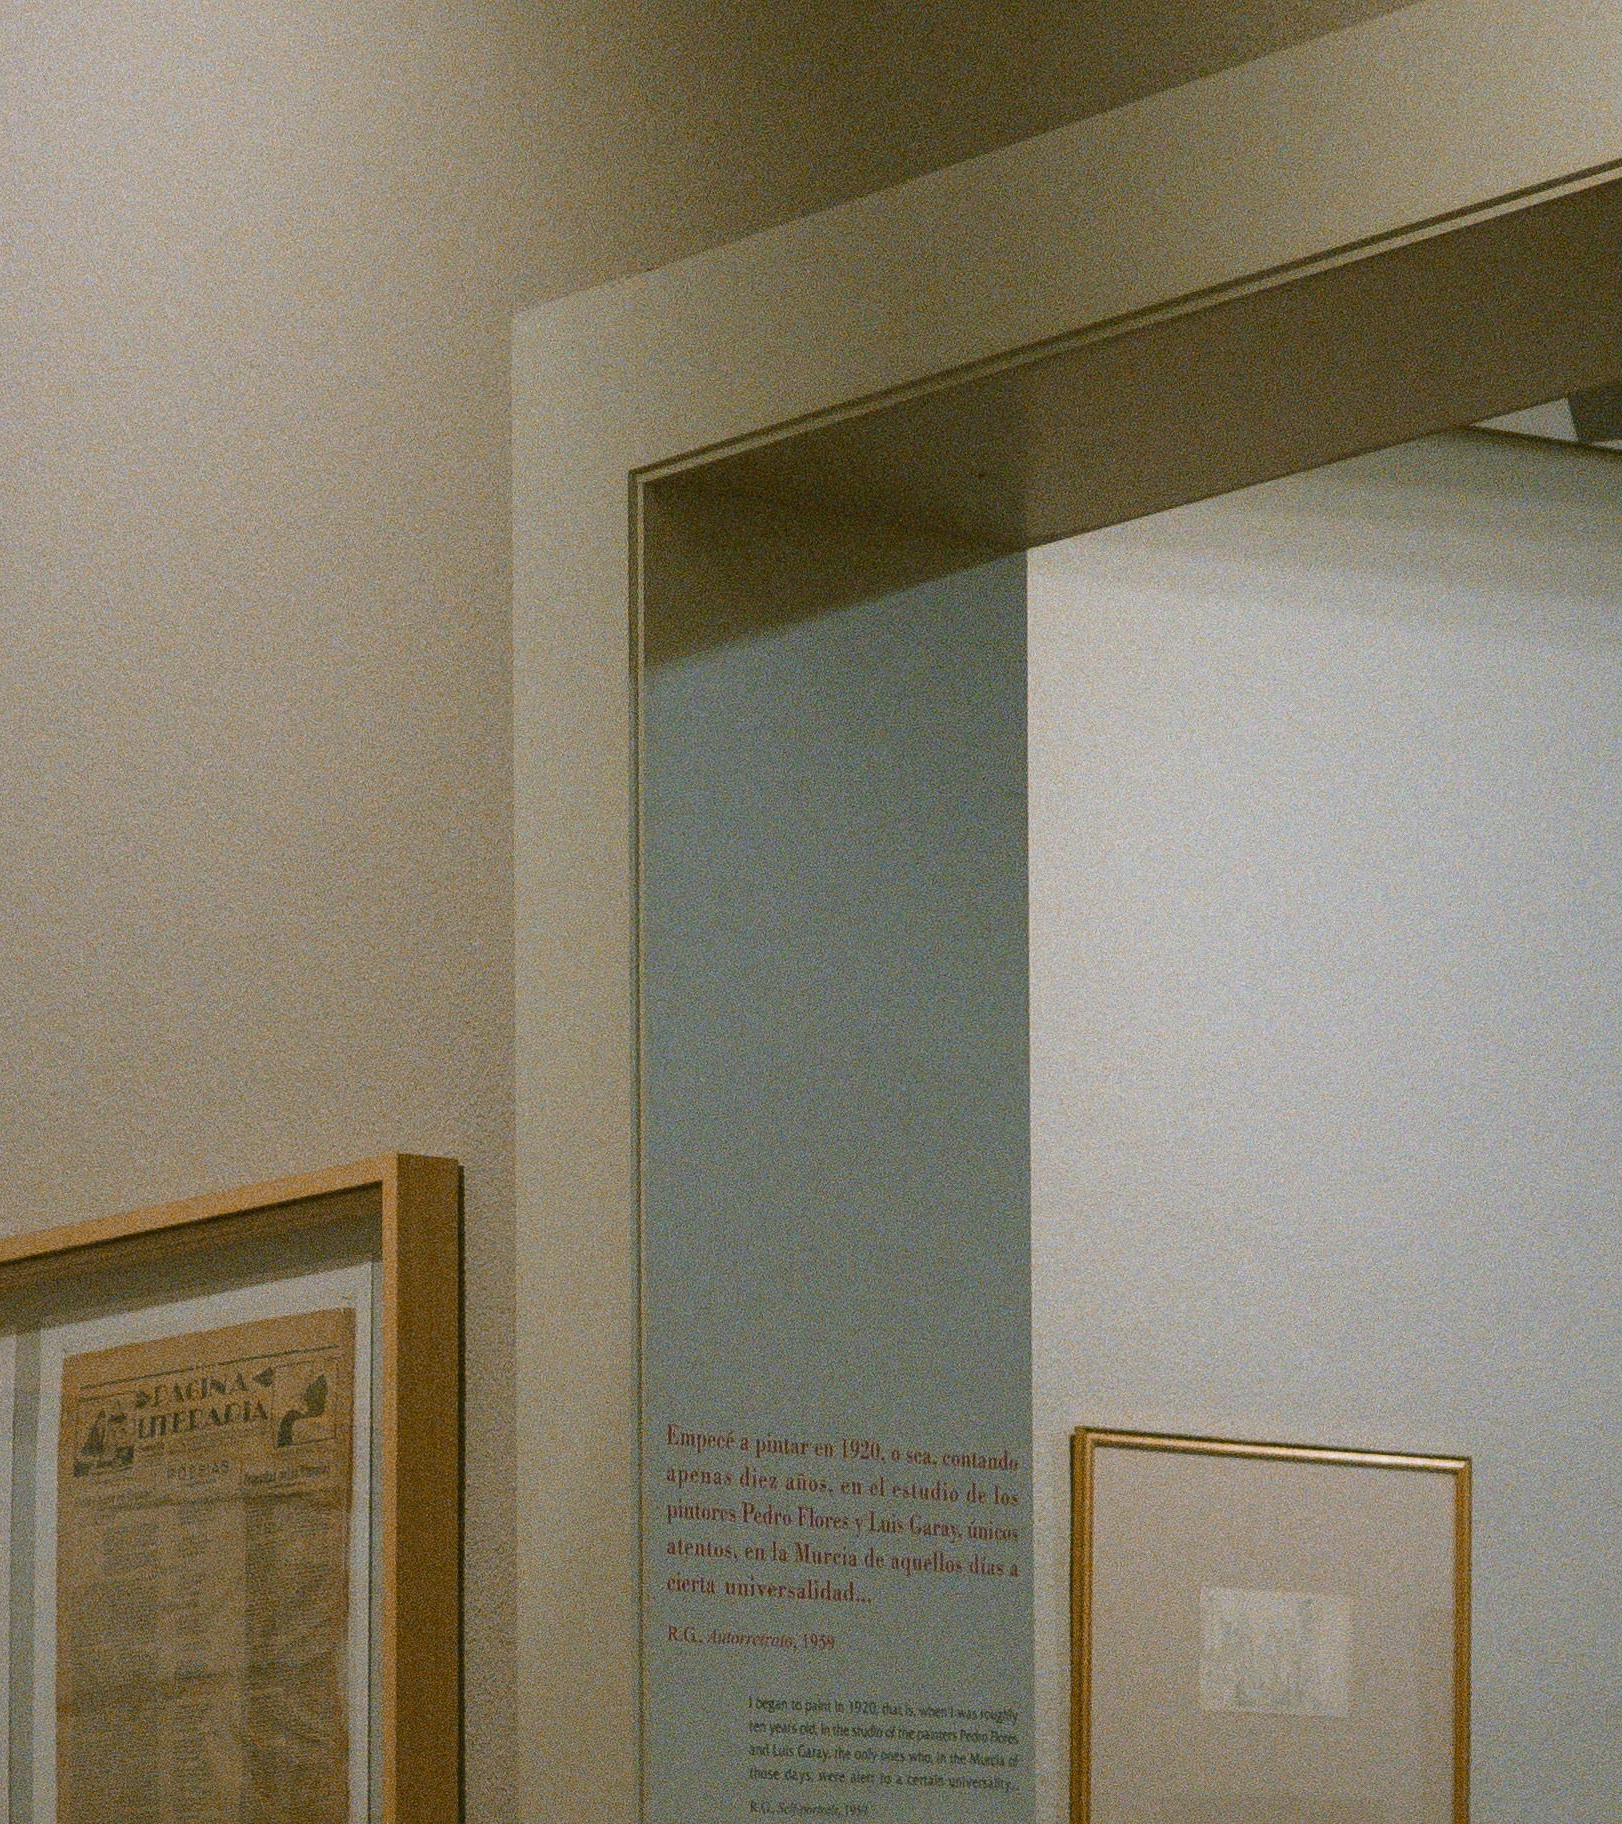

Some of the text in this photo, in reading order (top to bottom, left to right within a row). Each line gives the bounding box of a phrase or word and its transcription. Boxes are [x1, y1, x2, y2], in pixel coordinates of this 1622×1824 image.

[666, 1424, 1019, 1472] Empecé a pintar en 1920, o sea, contando
[666, 1466, 1019, 1506] apenas diez años, en el estudio de los
[667, 1499, 1019, 1543] pintores Pedro Flores y Luis Garay, únicos
[666, 1539, 1019, 1578] atentos, en la Murcia de aquellos días a
[666, 1571, 872, 1604] cierta universalidad...
[756, 1697, 788, 1714] began
[791, 1699, 803, 1712] to
[834, 1700, 845, 1713] in
[749, 1721, 766, 1735] ten
[769, 1722, 797, 1737] years
[820, 1723, 831, 1736] in
[832, 1724, 850, 1738] the
[852, 1724, 884, 1740] studio
[885, 1726, 896, 1740] of
[898, 1727, 915, 1741] the
[959, 1729, 988, 1743] Pedro
[749, 1744, 770, 1757] and
[834, 1747, 851, 1761] the
[949, 1751, 967, 1765] the
[969, 1752, 1005, 1768] Murcia
[749, 1767, 780, 1781] those
[818, 1771, 846, 1784] were
[879, 1772, 892, 1785] to
